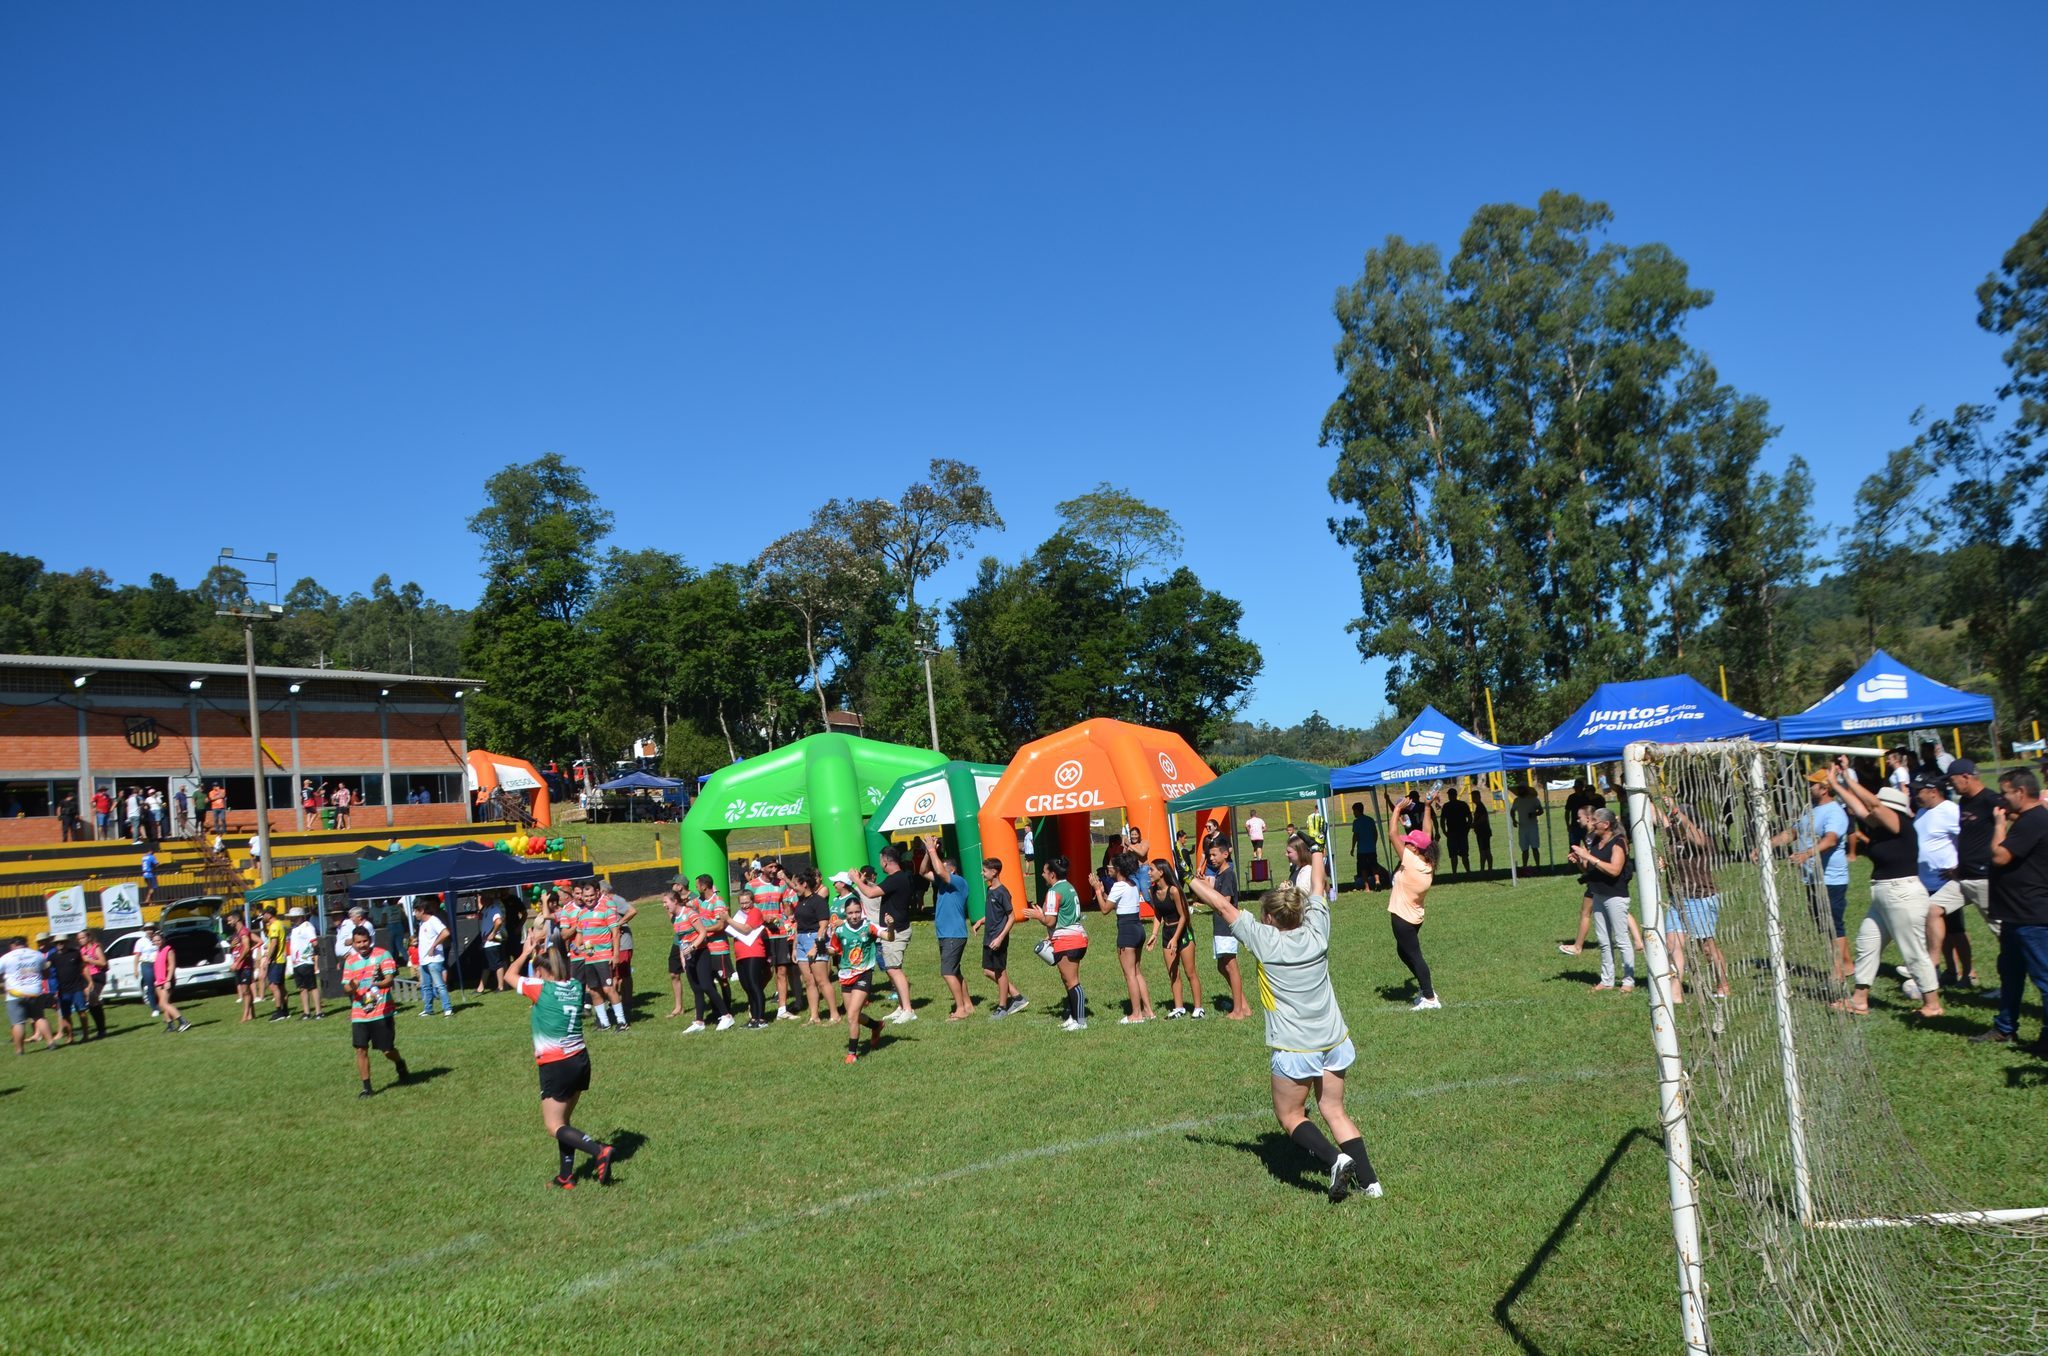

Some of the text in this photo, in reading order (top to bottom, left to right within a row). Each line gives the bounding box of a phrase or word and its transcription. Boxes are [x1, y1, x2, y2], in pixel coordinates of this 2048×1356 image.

[1577, 711, 1705, 739] Agroindústrias
[1585, 704, 1697, 727] Juntos pelos
[1390, 766, 1439, 779] EMATER/RS
[1025, 789, 1105, 813] CRESOL
[898, 813, 938, 827] CRESOL
[562, 1005, 577, 1033] 7
